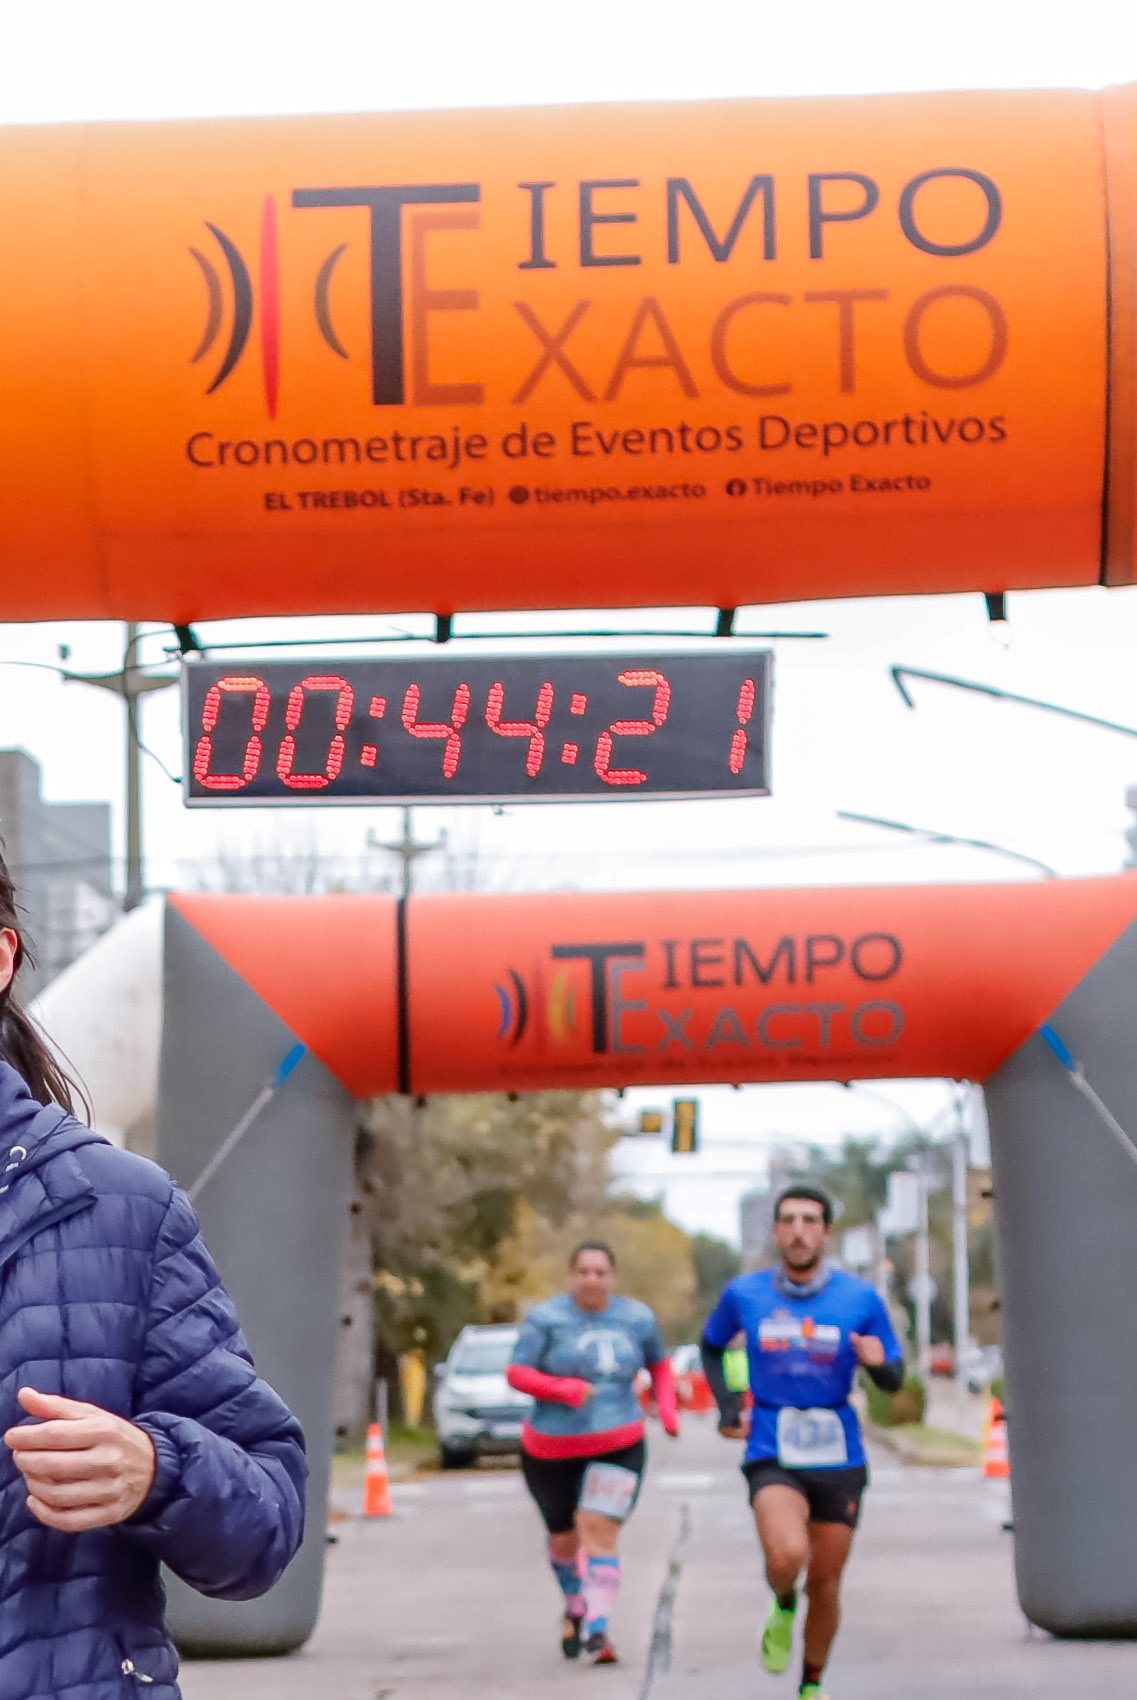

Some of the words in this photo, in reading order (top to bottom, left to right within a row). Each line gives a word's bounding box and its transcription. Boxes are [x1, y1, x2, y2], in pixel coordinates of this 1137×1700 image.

[290, 166, 1003, 406] TIEMPO
[406, 210, 1009, 407] EXACTO
[185, 425, 487, 469] Cronometraje
[502, 422, 555, 459] de
[570, 420, 743, 457] Eventos
[758, 410, 1007, 456] Deportivos
[264, 491, 291, 511] EL
[298, 488, 391, 509] TREBOL
[459, 485, 495, 507] Fe)
[534, 481, 707, 506] tiempo.exacto
[752, 476, 843, 498] Tiempo
[849, 473, 931, 494] Exacto
[551, 932, 904, 1054] TIEMPO
[608, 957, 904, 1054] EXACTO
